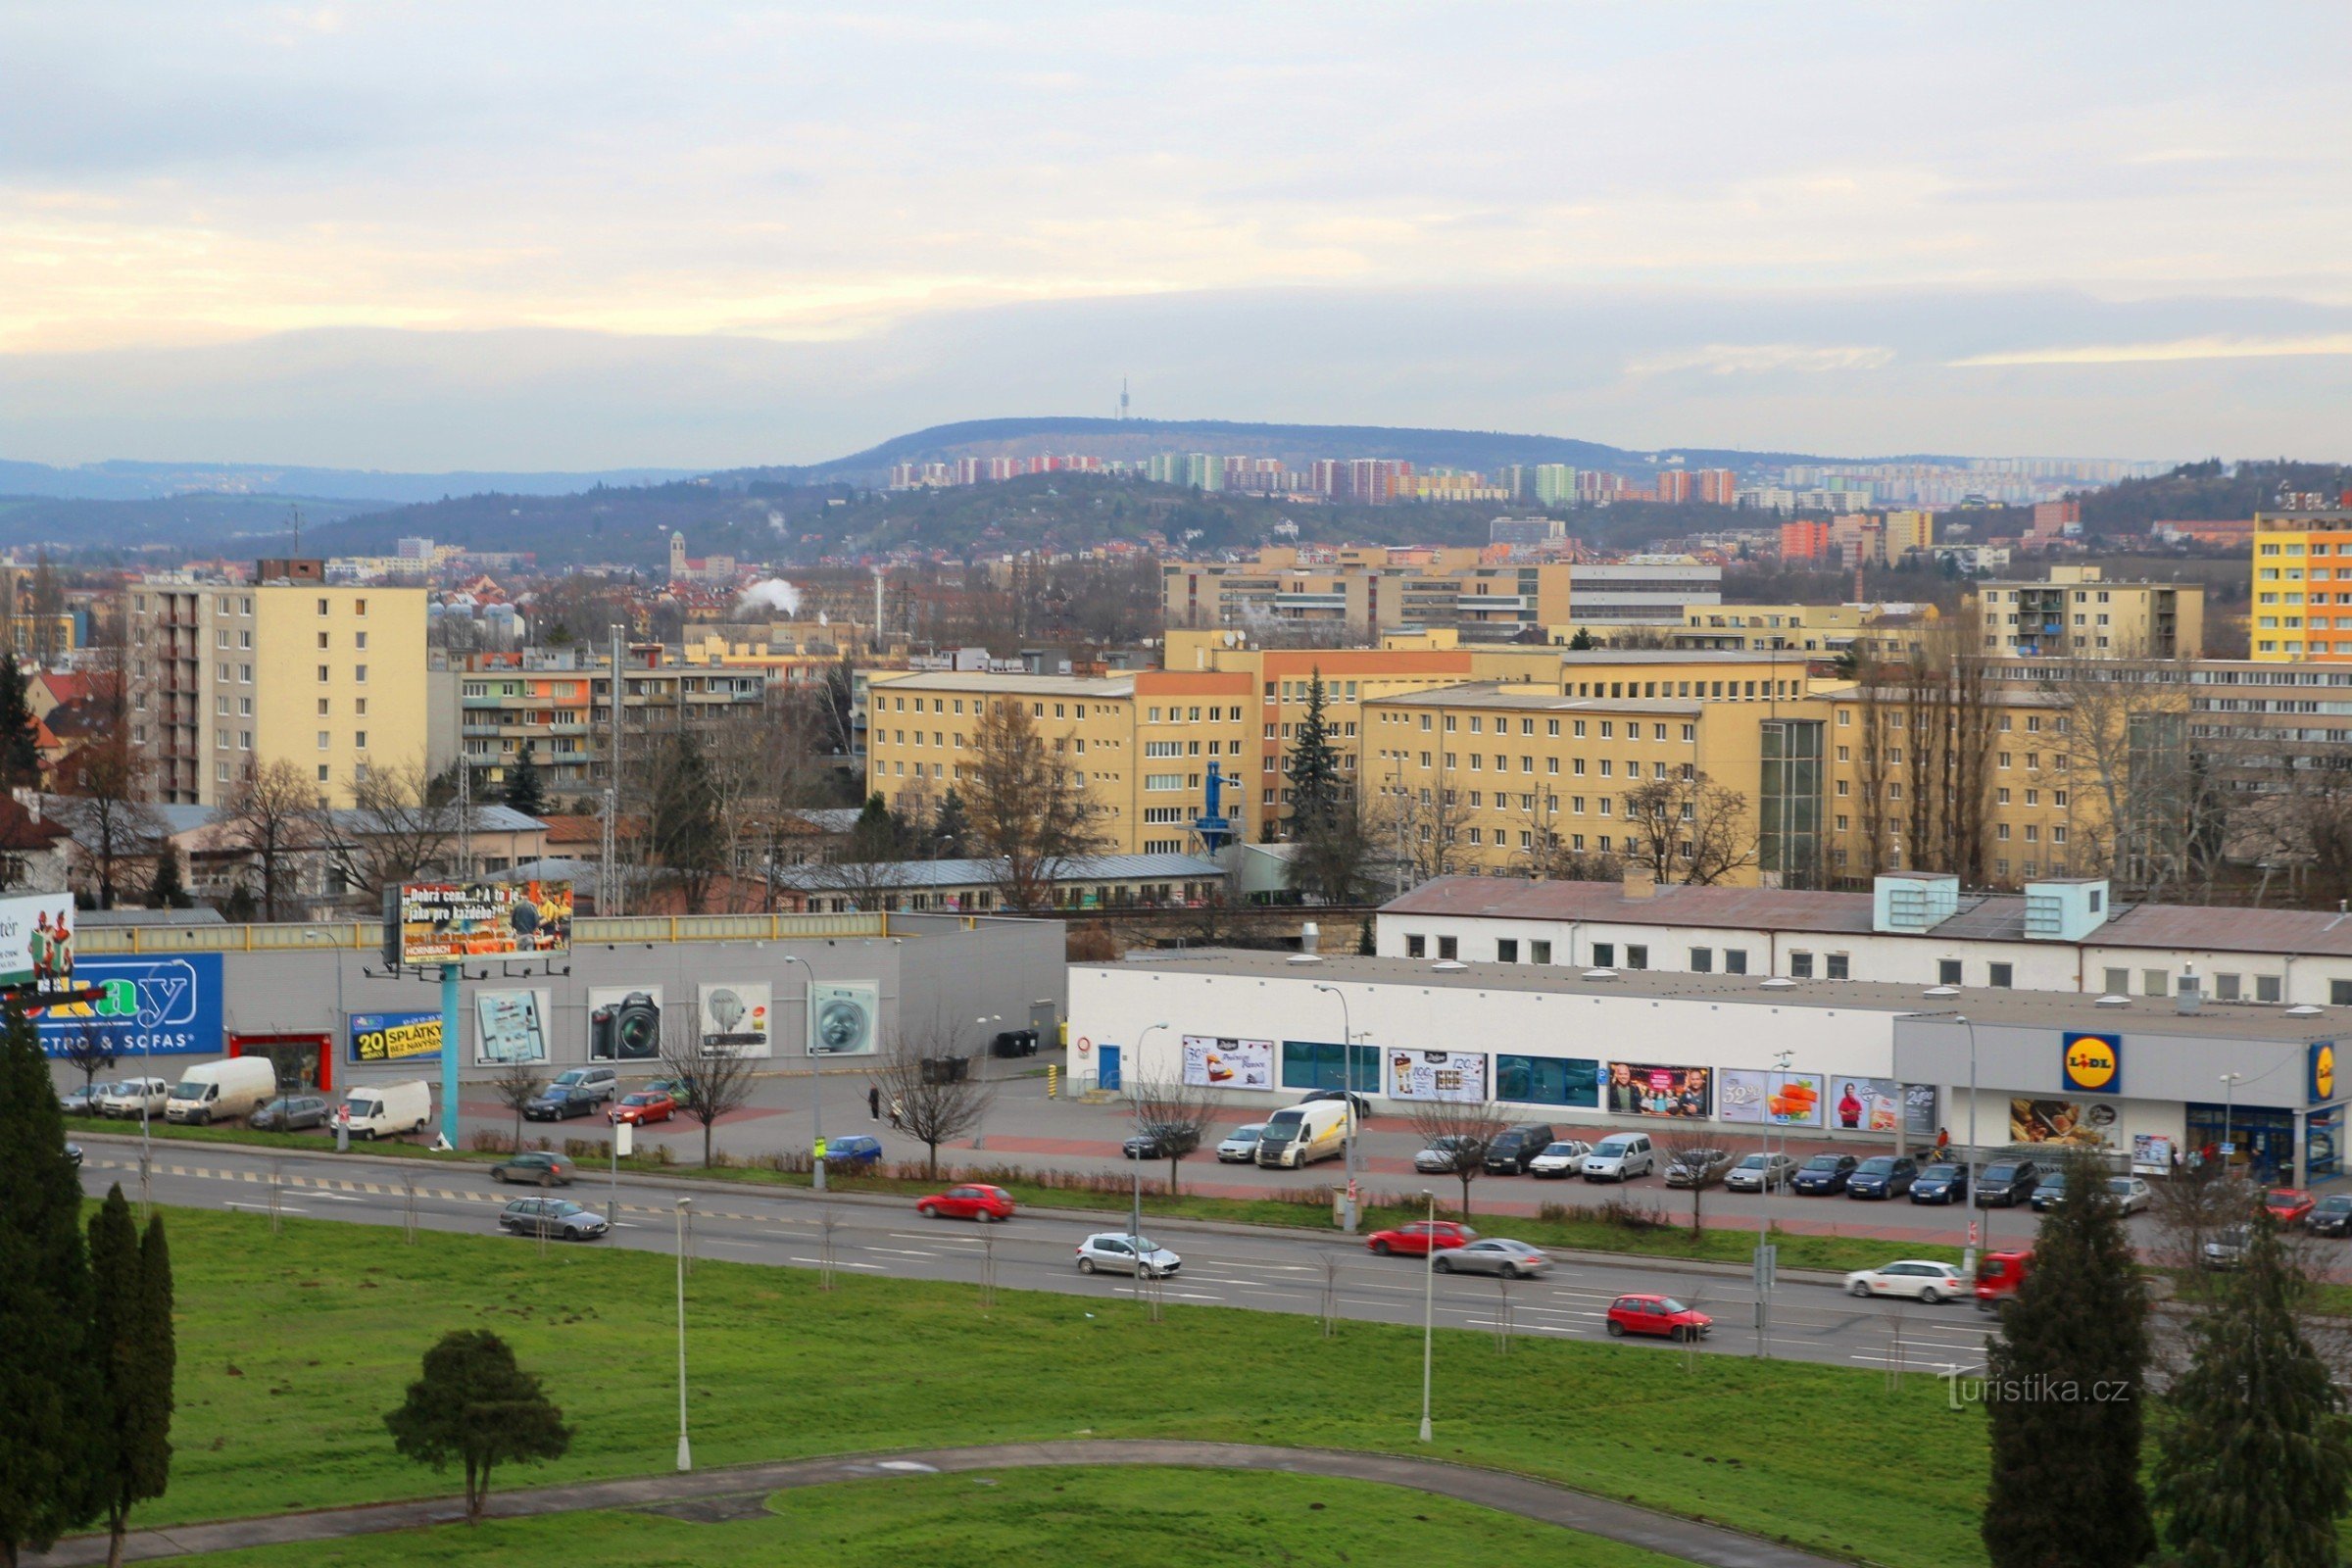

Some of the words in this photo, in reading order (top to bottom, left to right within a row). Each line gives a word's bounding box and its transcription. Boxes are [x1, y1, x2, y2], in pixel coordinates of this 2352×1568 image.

[483, 889, 491, 903] A
[494, 889, 505, 902] to
[509, 889, 519, 906] je
[408, 906, 430, 923] jako
[433, 907, 450, 924] pro
[101, 1036, 113, 1050] &
[359, 1032, 384, 1054] 20
